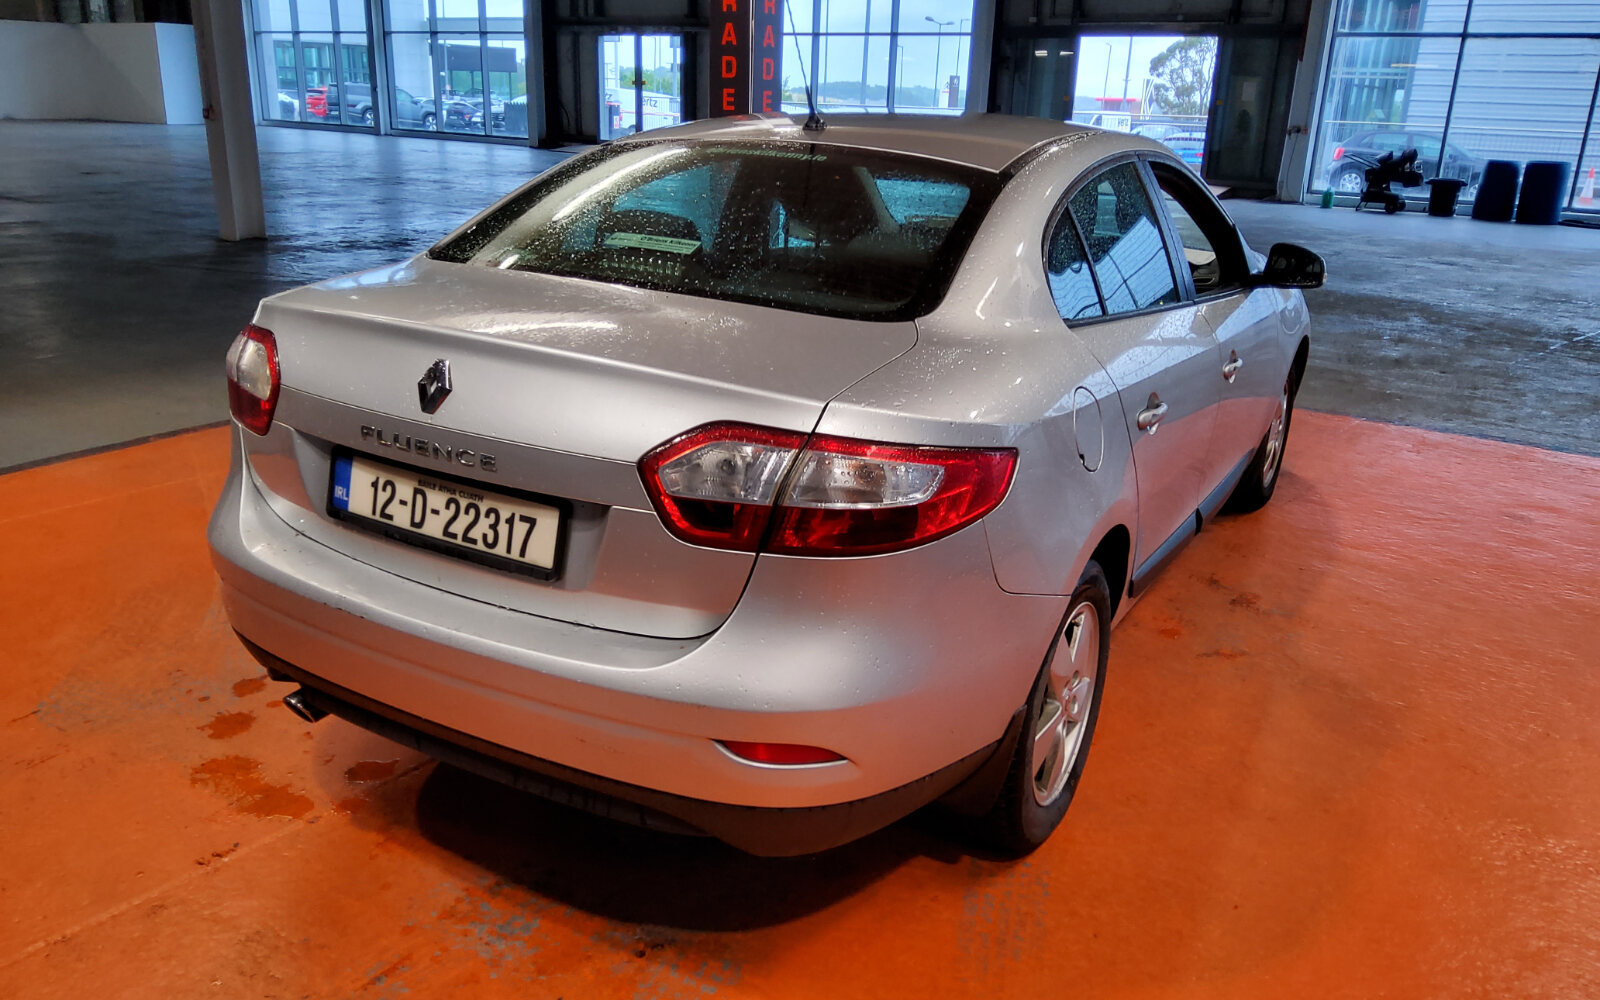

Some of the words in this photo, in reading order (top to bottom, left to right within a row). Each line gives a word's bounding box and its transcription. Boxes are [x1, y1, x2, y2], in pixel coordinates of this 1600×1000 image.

[360, 424, 498, 473] FLUENCE
[334, 485, 350, 501] IRL
[370, 476, 537, 559] 12-D-22317
